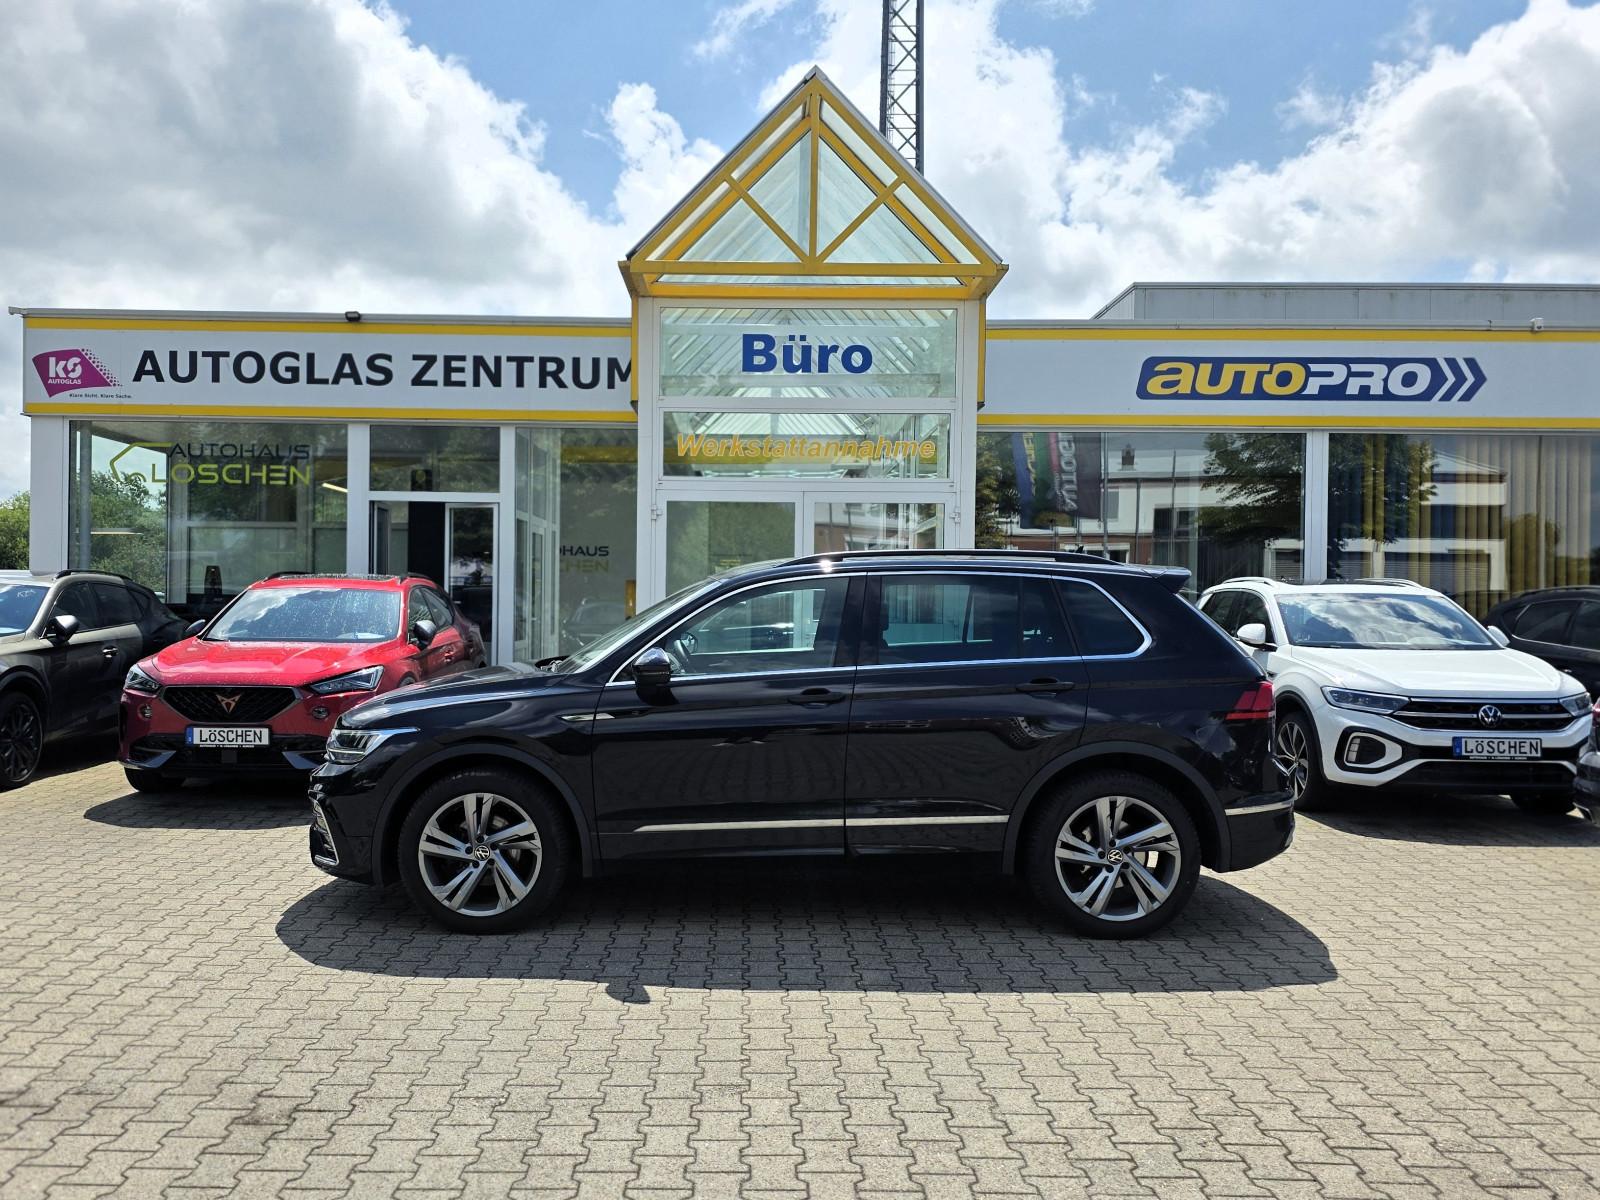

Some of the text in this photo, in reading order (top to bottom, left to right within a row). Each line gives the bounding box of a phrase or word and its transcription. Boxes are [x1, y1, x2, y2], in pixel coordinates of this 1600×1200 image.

[742, 334, 873, 374] Büro
[132, 349, 632, 389] AUTOGLAS ZENTRUM
[169, 443, 310, 457] AUTOHAUS
[677, 434, 937, 459] Werkstattannahme
[559, 545, 609, 557] HAUS
[199, 729, 263, 743] LÖSCHEN
[1464, 740, 1539, 755] LÖSCHEN
